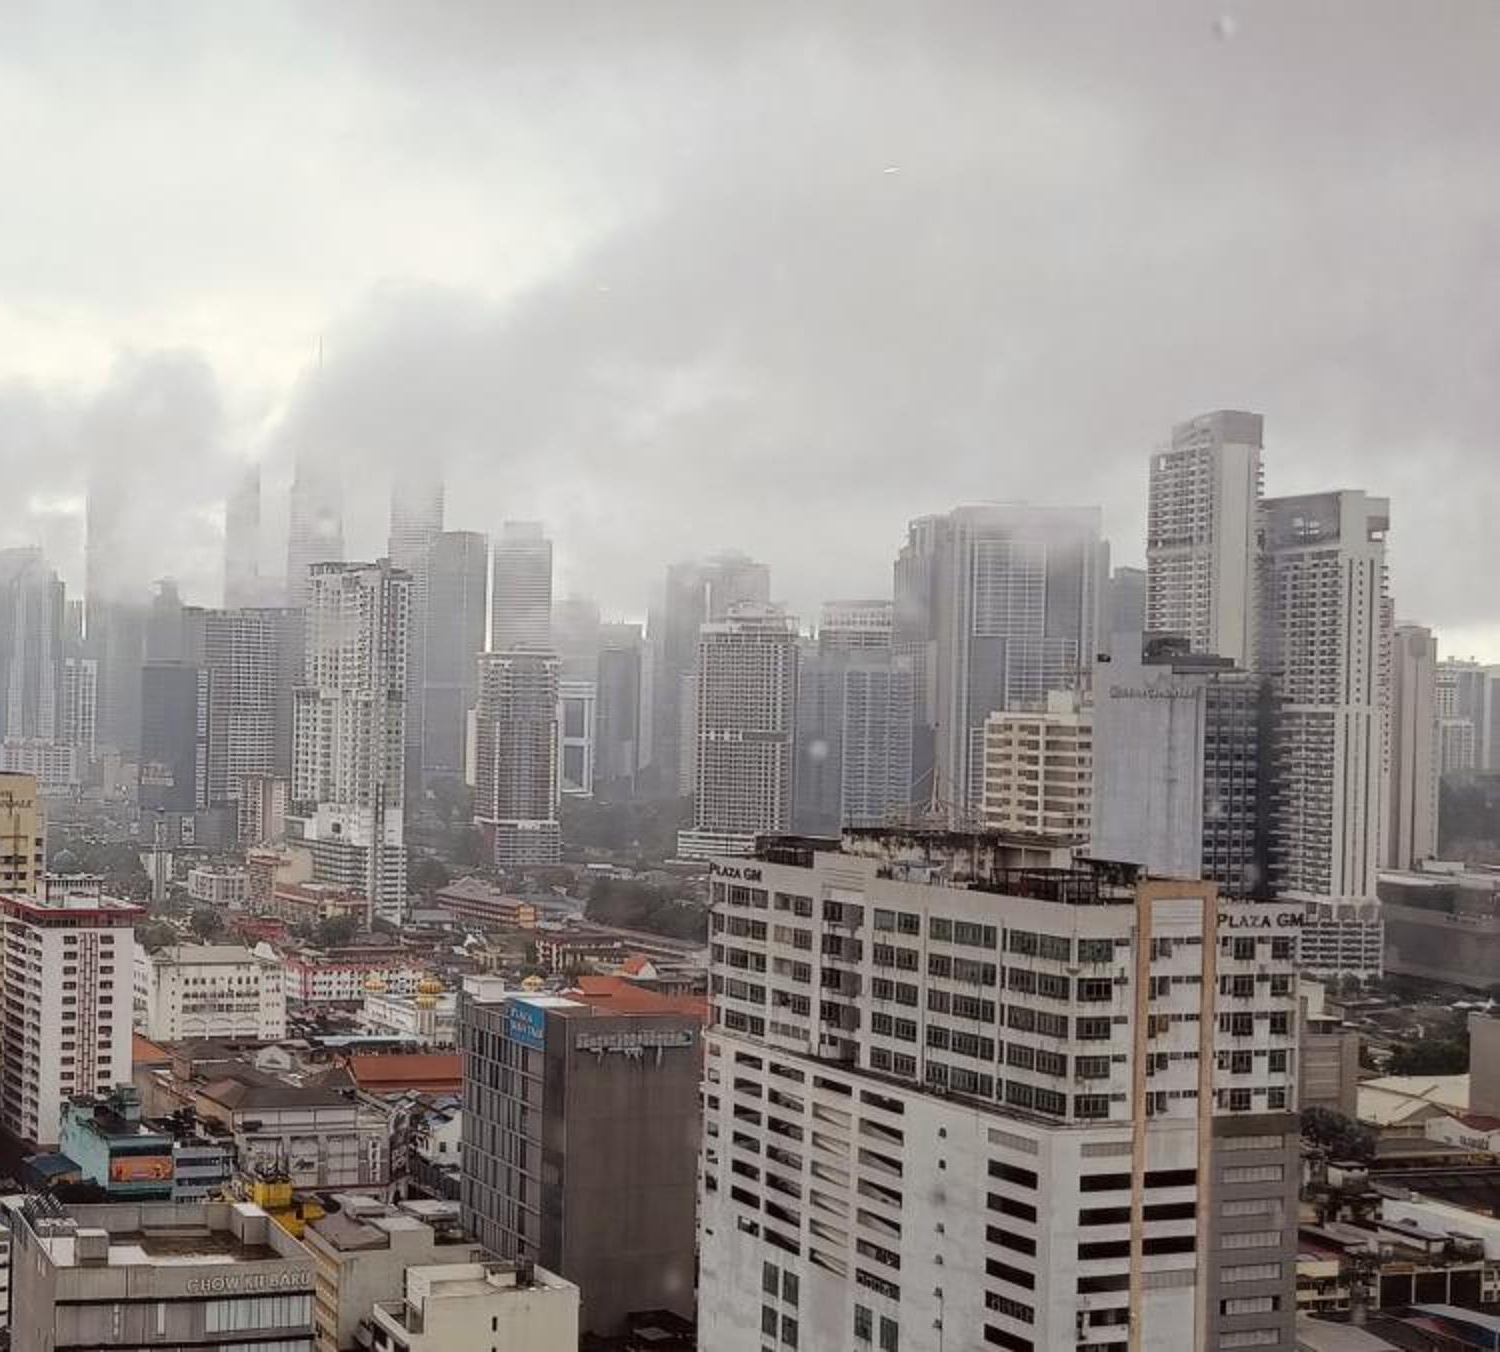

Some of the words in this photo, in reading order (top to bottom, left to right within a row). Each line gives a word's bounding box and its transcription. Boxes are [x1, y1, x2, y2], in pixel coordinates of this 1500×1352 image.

[710, 862, 741, 879] PLAZA
[743, 867, 762, 882] GM
[1217, 913, 1272, 928] PLAZA
[1276, 913, 1304, 927] GM
[186, 1276, 239, 1294] CHOW
[269, 1270, 310, 1289] BARU
